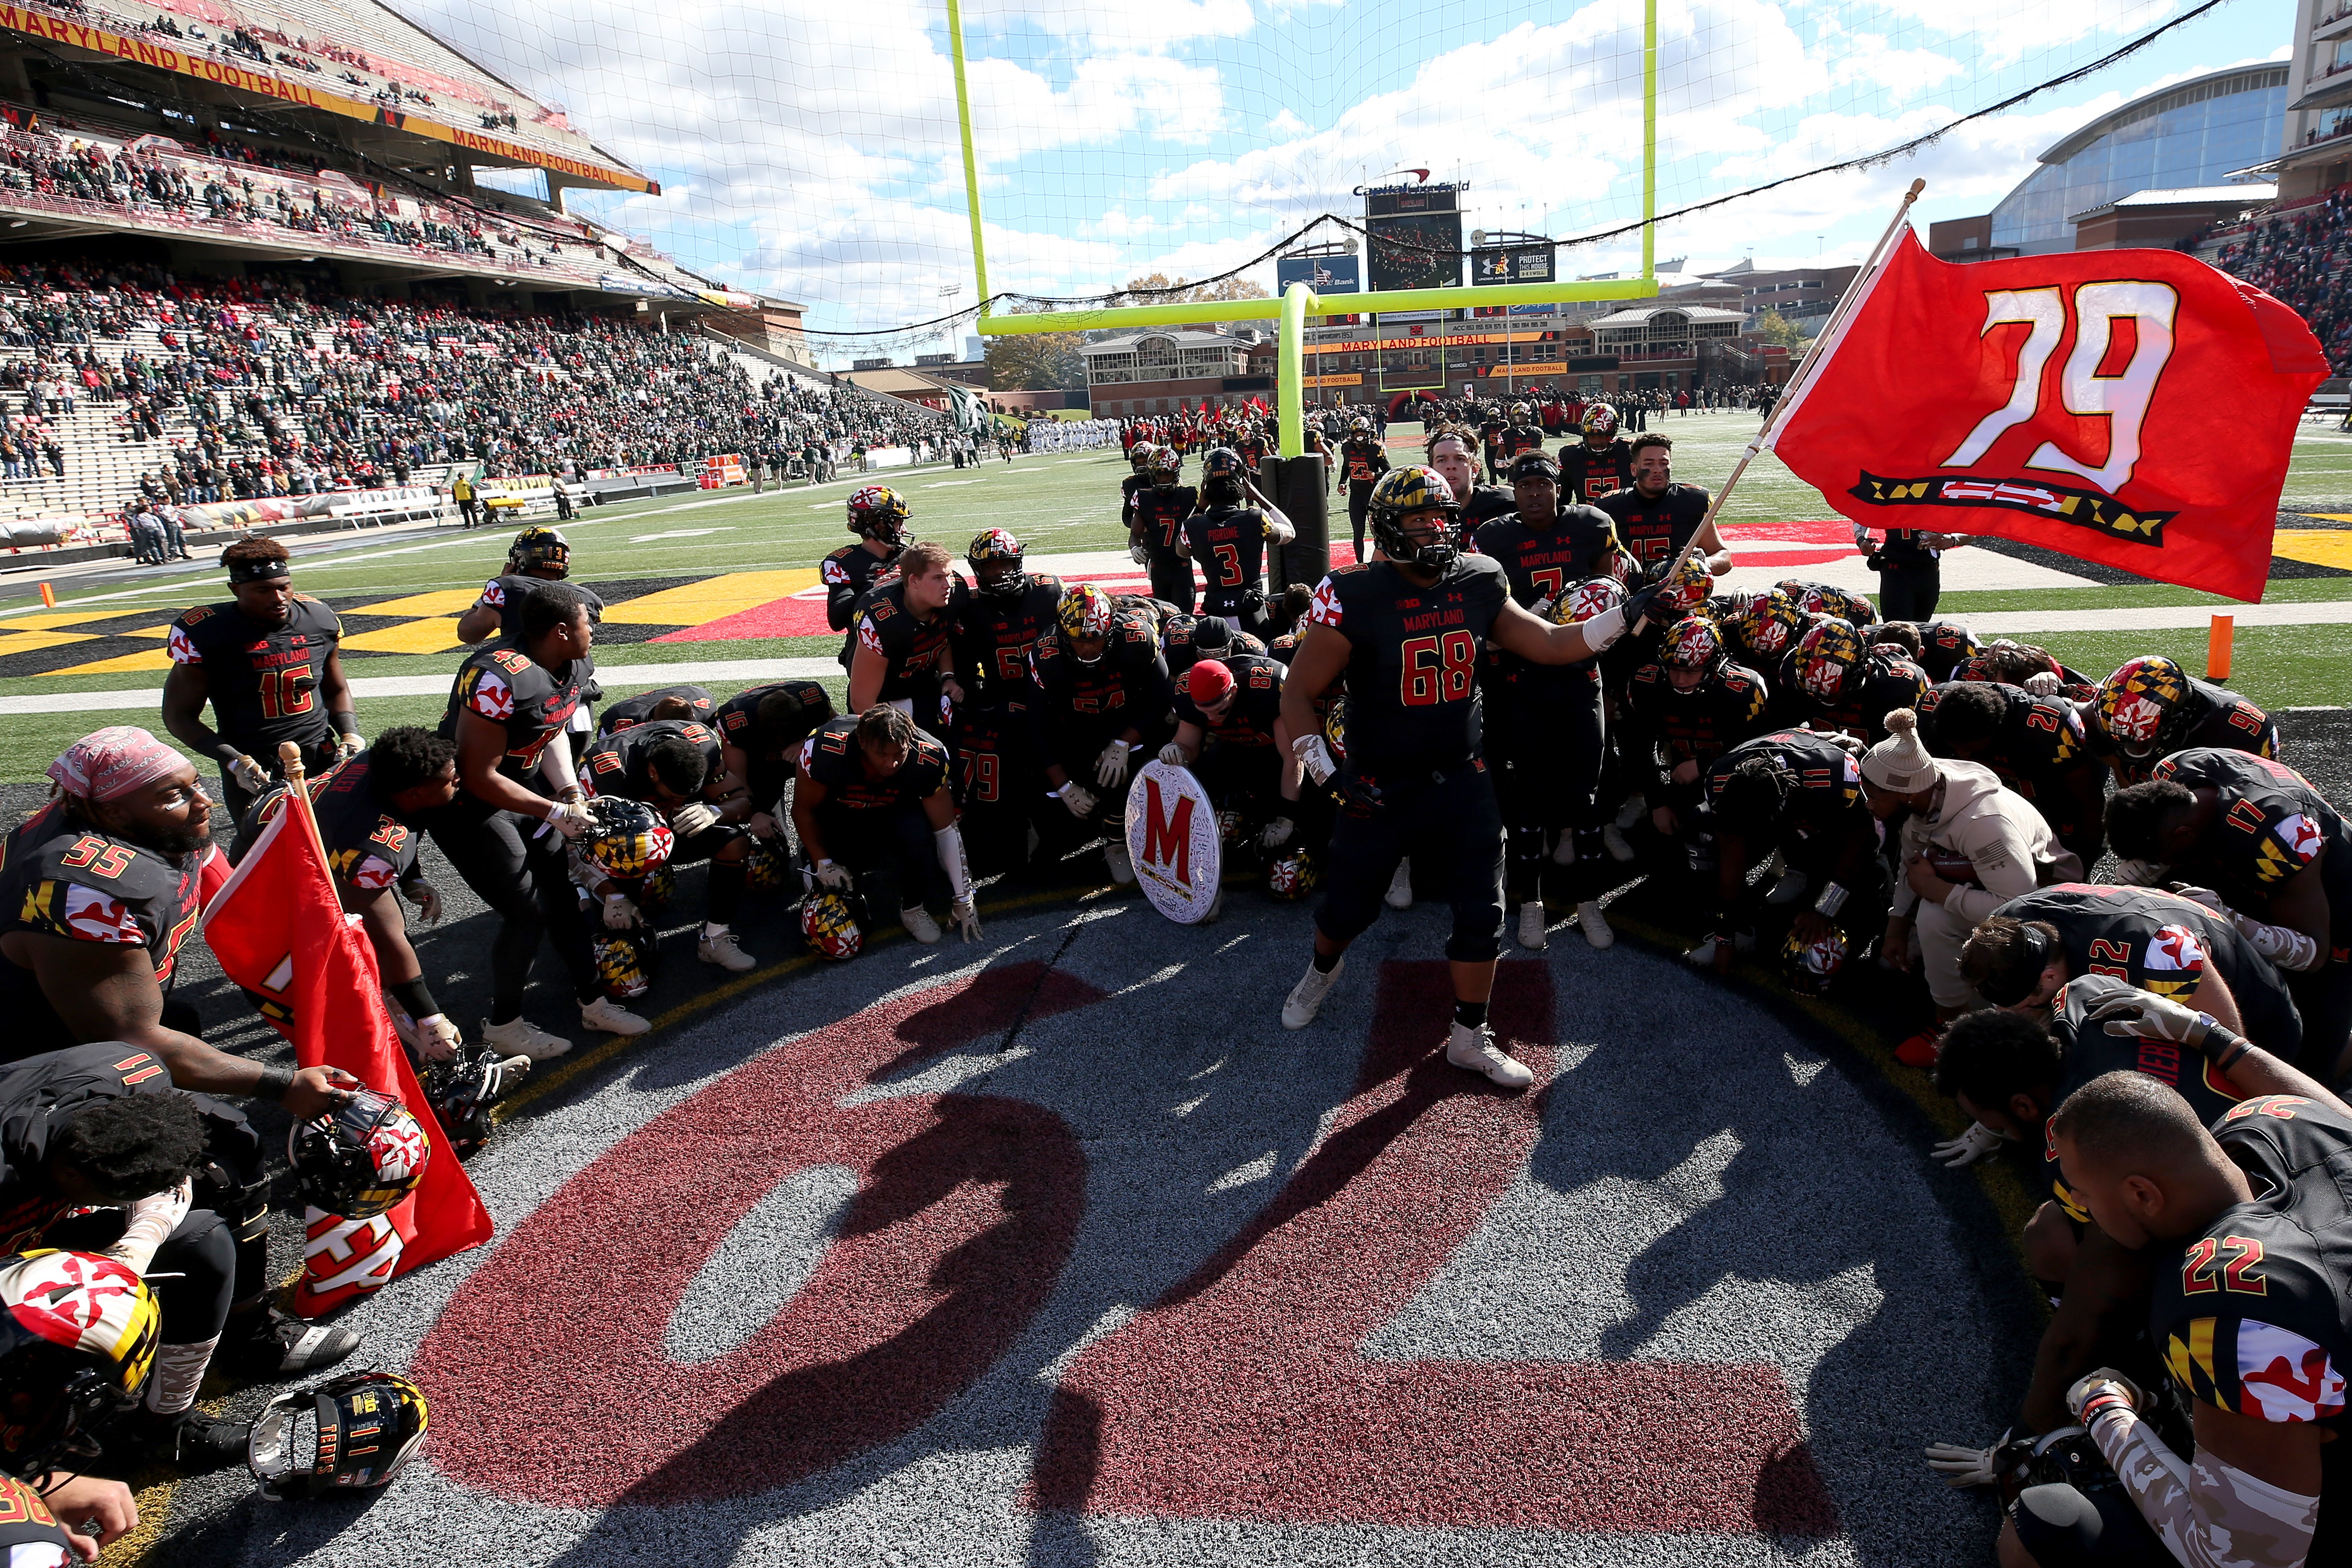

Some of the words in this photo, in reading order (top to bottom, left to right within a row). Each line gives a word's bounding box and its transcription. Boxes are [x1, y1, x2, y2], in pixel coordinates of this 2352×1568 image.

[0, 5, 178, 71] MARYLAND
[187, 55, 321, 108] FOOTBALL
[454, 128, 541, 165] MARYLAND
[547, 155, 616, 184] FOOTBALL
[1519, 255, 1548, 264] PROTECT
[1342, 338, 1416, 352] MARYLAND
[1421, 334, 1491, 347] FOOTBALL
[1411, 326, 1422, 335] 25
[1937, 277, 2180, 495] 79
[488, 475, 553, 491] TERRAPIN
[1587, 467, 1616, 476] MARYLAND
[1159, 518, 1175, 547] 7
[1207, 525, 1240, 542] PIGROME
[1628, 524, 1672, 536] MARYLAND
[542, 561, 564, 570] TERPS
[1213, 543, 1244, 587] 3
[1519, 550, 1573, 568] MARYLAND
[1531, 567, 1563, 601] 7
[869, 597, 898, 622] 76
[1403, 608, 1465, 632] MARYLAND
[251, 648, 310, 670] MARYLAND
[492, 648, 532, 675] 49
[1037, 636, 1060, 660] 54
[1250, 666, 1274, 690] 82
[1401, 629, 1476, 707] 68
[258, 664, 314, 720] 16
[543, 700, 576, 725] MARYLAND
[725, 710, 749, 731] 16
[2026, 704, 2062, 733] 21
[2228, 700, 2267, 737] 98
[592, 750, 622, 775] 10
[958, 748, 1000, 802] 79
[1803, 769, 1831, 789] 11
[2225, 797, 2267, 834] 17
[369, 813, 409, 854] 32
[1141, 775, 1197, 889] M
[60, 835, 137, 880] 55
[112, 1052, 165, 1086] 11
[2182, 1235, 2268, 1297] 22
[317, 1423, 338, 1475] TERPS
[348, 1426, 381, 1457] 11
[339, 1473, 349, 1485] 79
